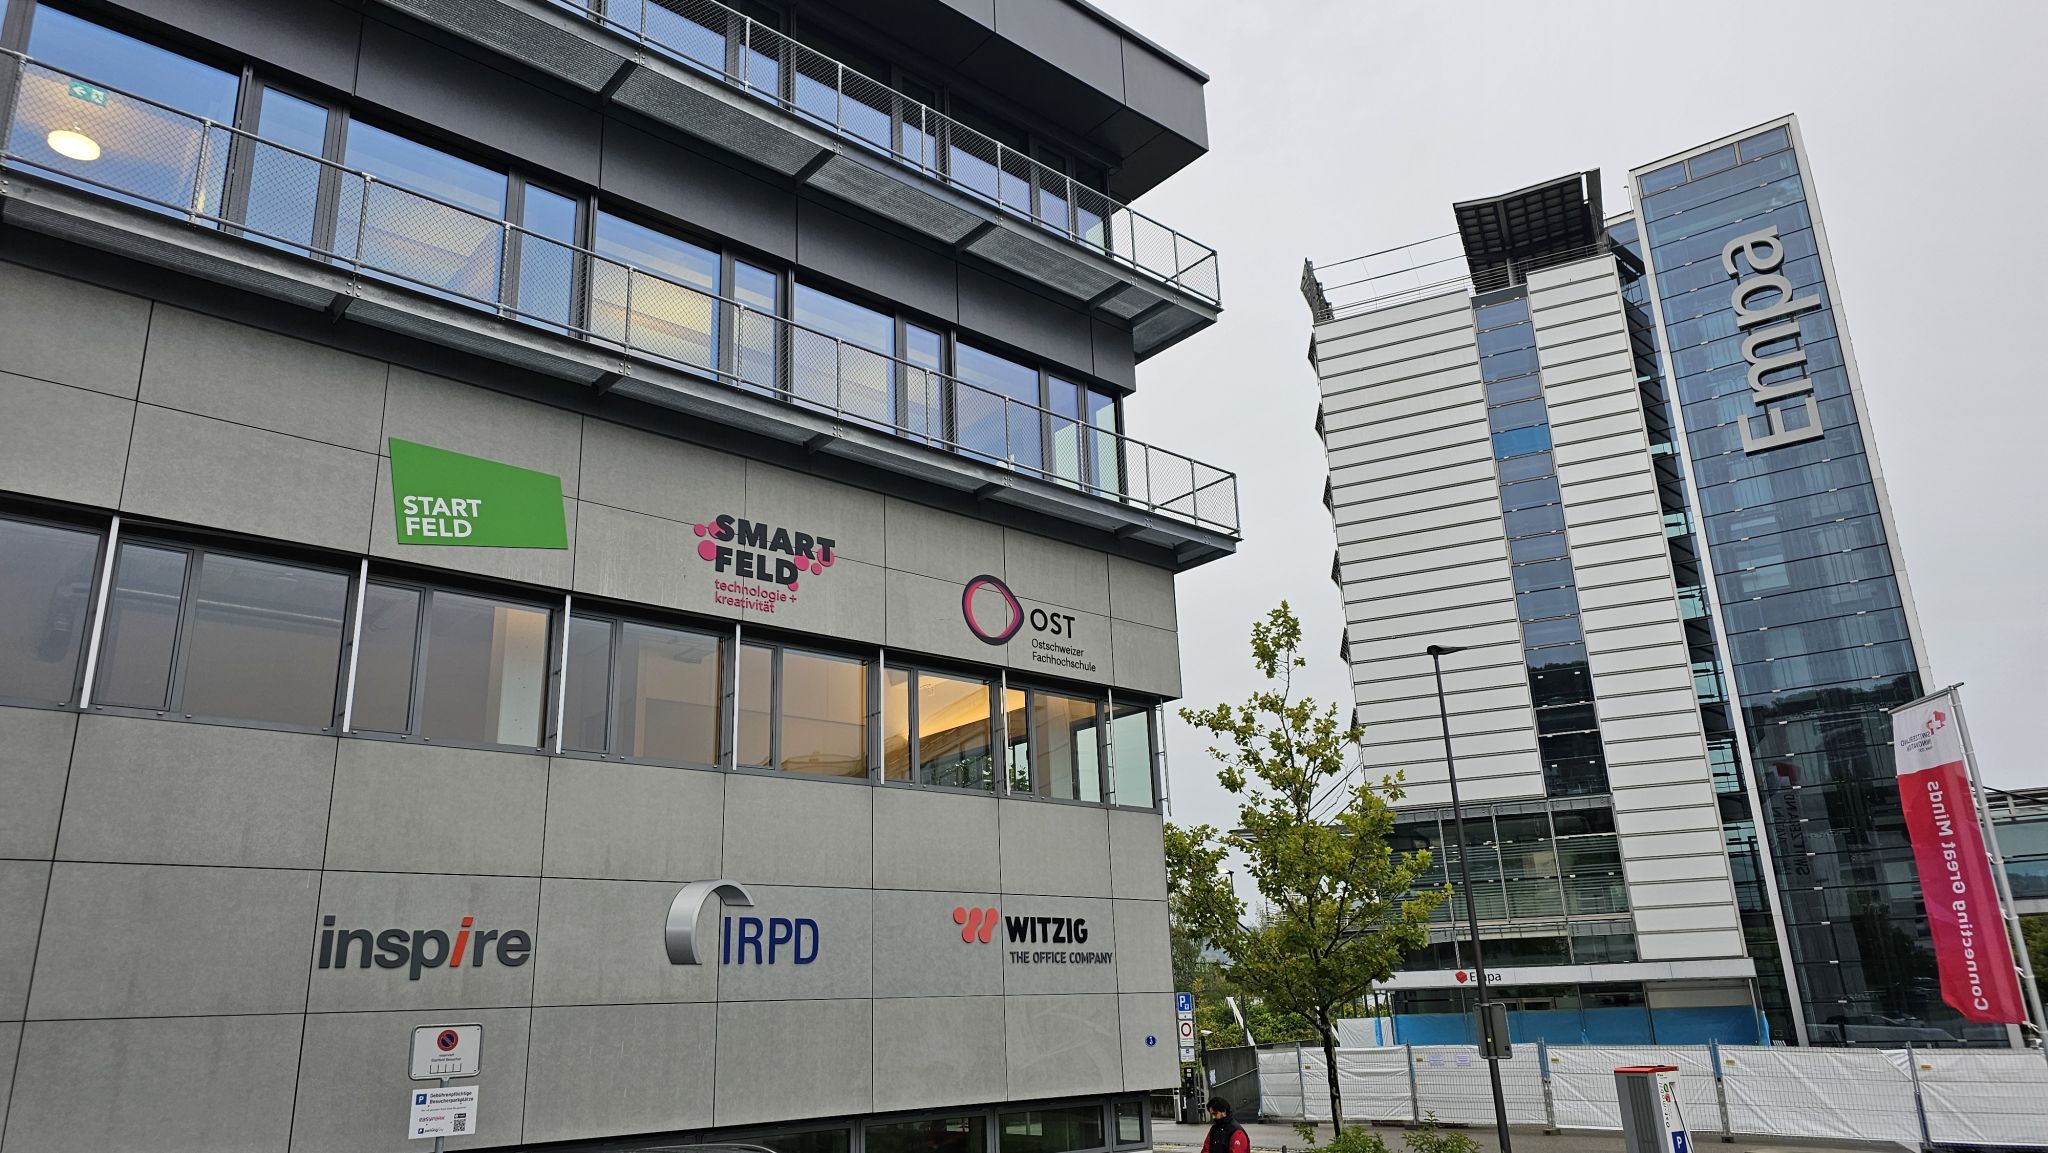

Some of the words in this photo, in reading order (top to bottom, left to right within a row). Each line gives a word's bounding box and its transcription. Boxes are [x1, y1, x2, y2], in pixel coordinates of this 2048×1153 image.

[1722, 225, 1825, 457] Empa
[403, 495, 482, 518] START
[405, 517, 473, 538] FELD
[715, 514, 836, 563] SMART
[715, 545, 799, 586] FELD
[714, 578, 787, 603] technologie
[789, 594, 797, 604] +
[714, 591, 775, 613] kreativität
[1030, 608, 1076, 639] OST
[1031, 638, 1084, 658] Ostschweizer
[1032, 651, 1096, 673] Fachhochschule
[722, 916, 819, 965] IRPD
[1005, 916, 1088, 944] WITZIG
[318, 915, 532, 981] inspire
[1010, 951, 1031, 964] THE
[1033, 952, 1067, 964] OFFICE
[1069, 952, 1113, 965] COMPANY
[1470, 971, 1502, 985] Epa
